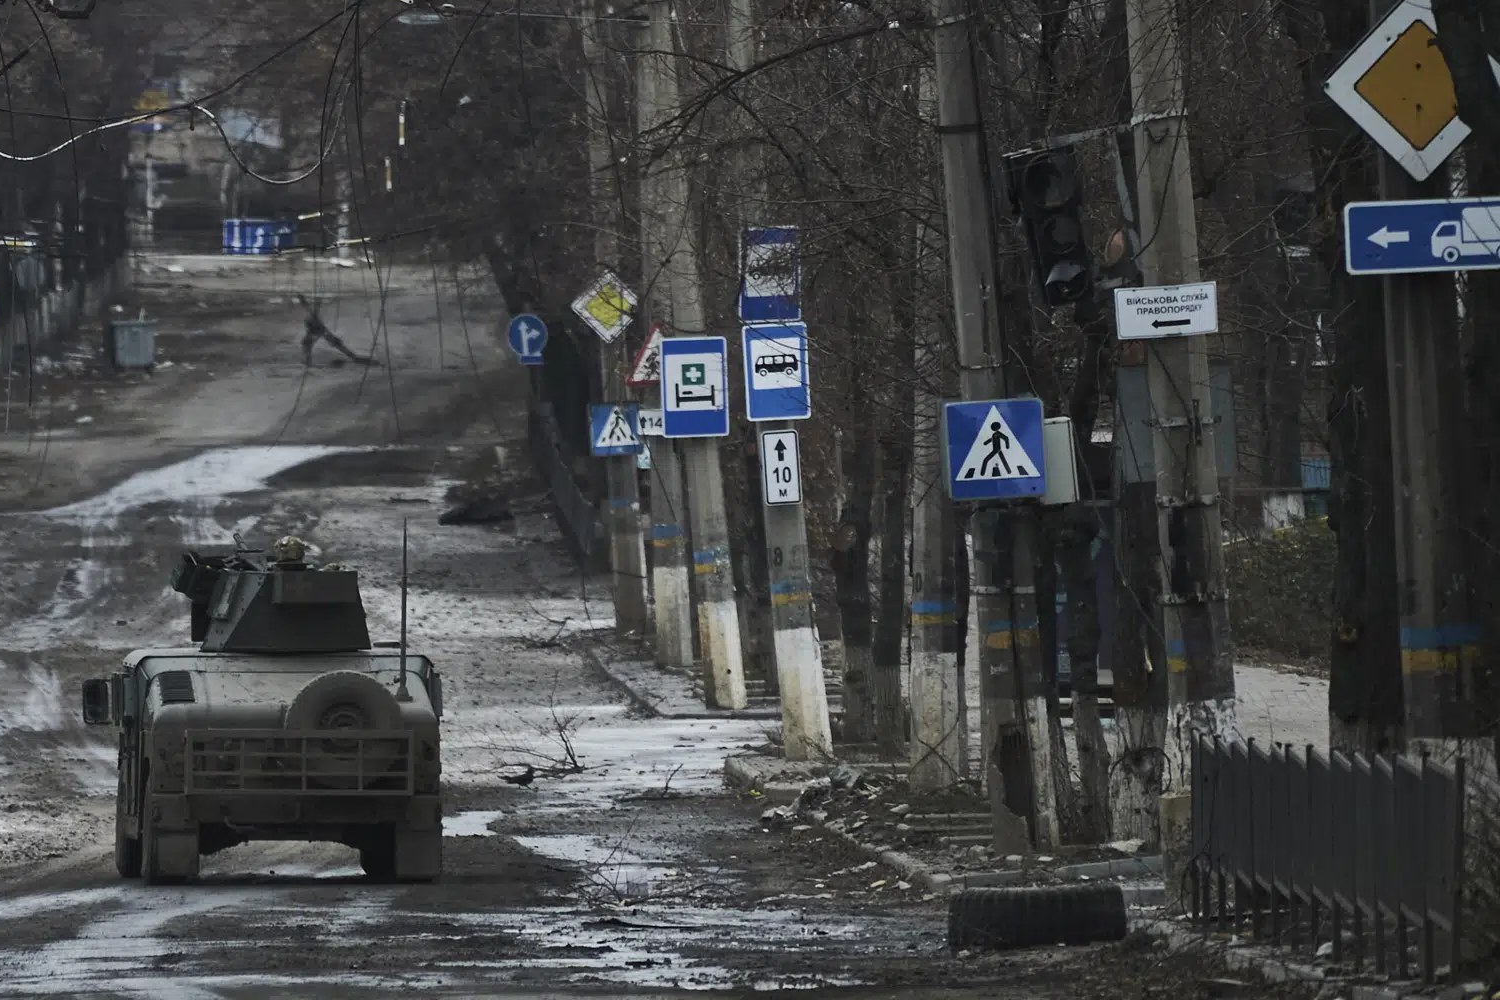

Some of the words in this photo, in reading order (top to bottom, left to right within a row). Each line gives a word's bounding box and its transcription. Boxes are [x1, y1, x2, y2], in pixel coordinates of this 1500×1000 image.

[1126, 295, 1179, 306] ВІЙСЬКОВА
[1180, 293, 1209, 303] СЛУЖБА
[1136, 304, 1202, 315] ПРАВОПОРЯДКУ
[772, 466, 792, 484] 10
